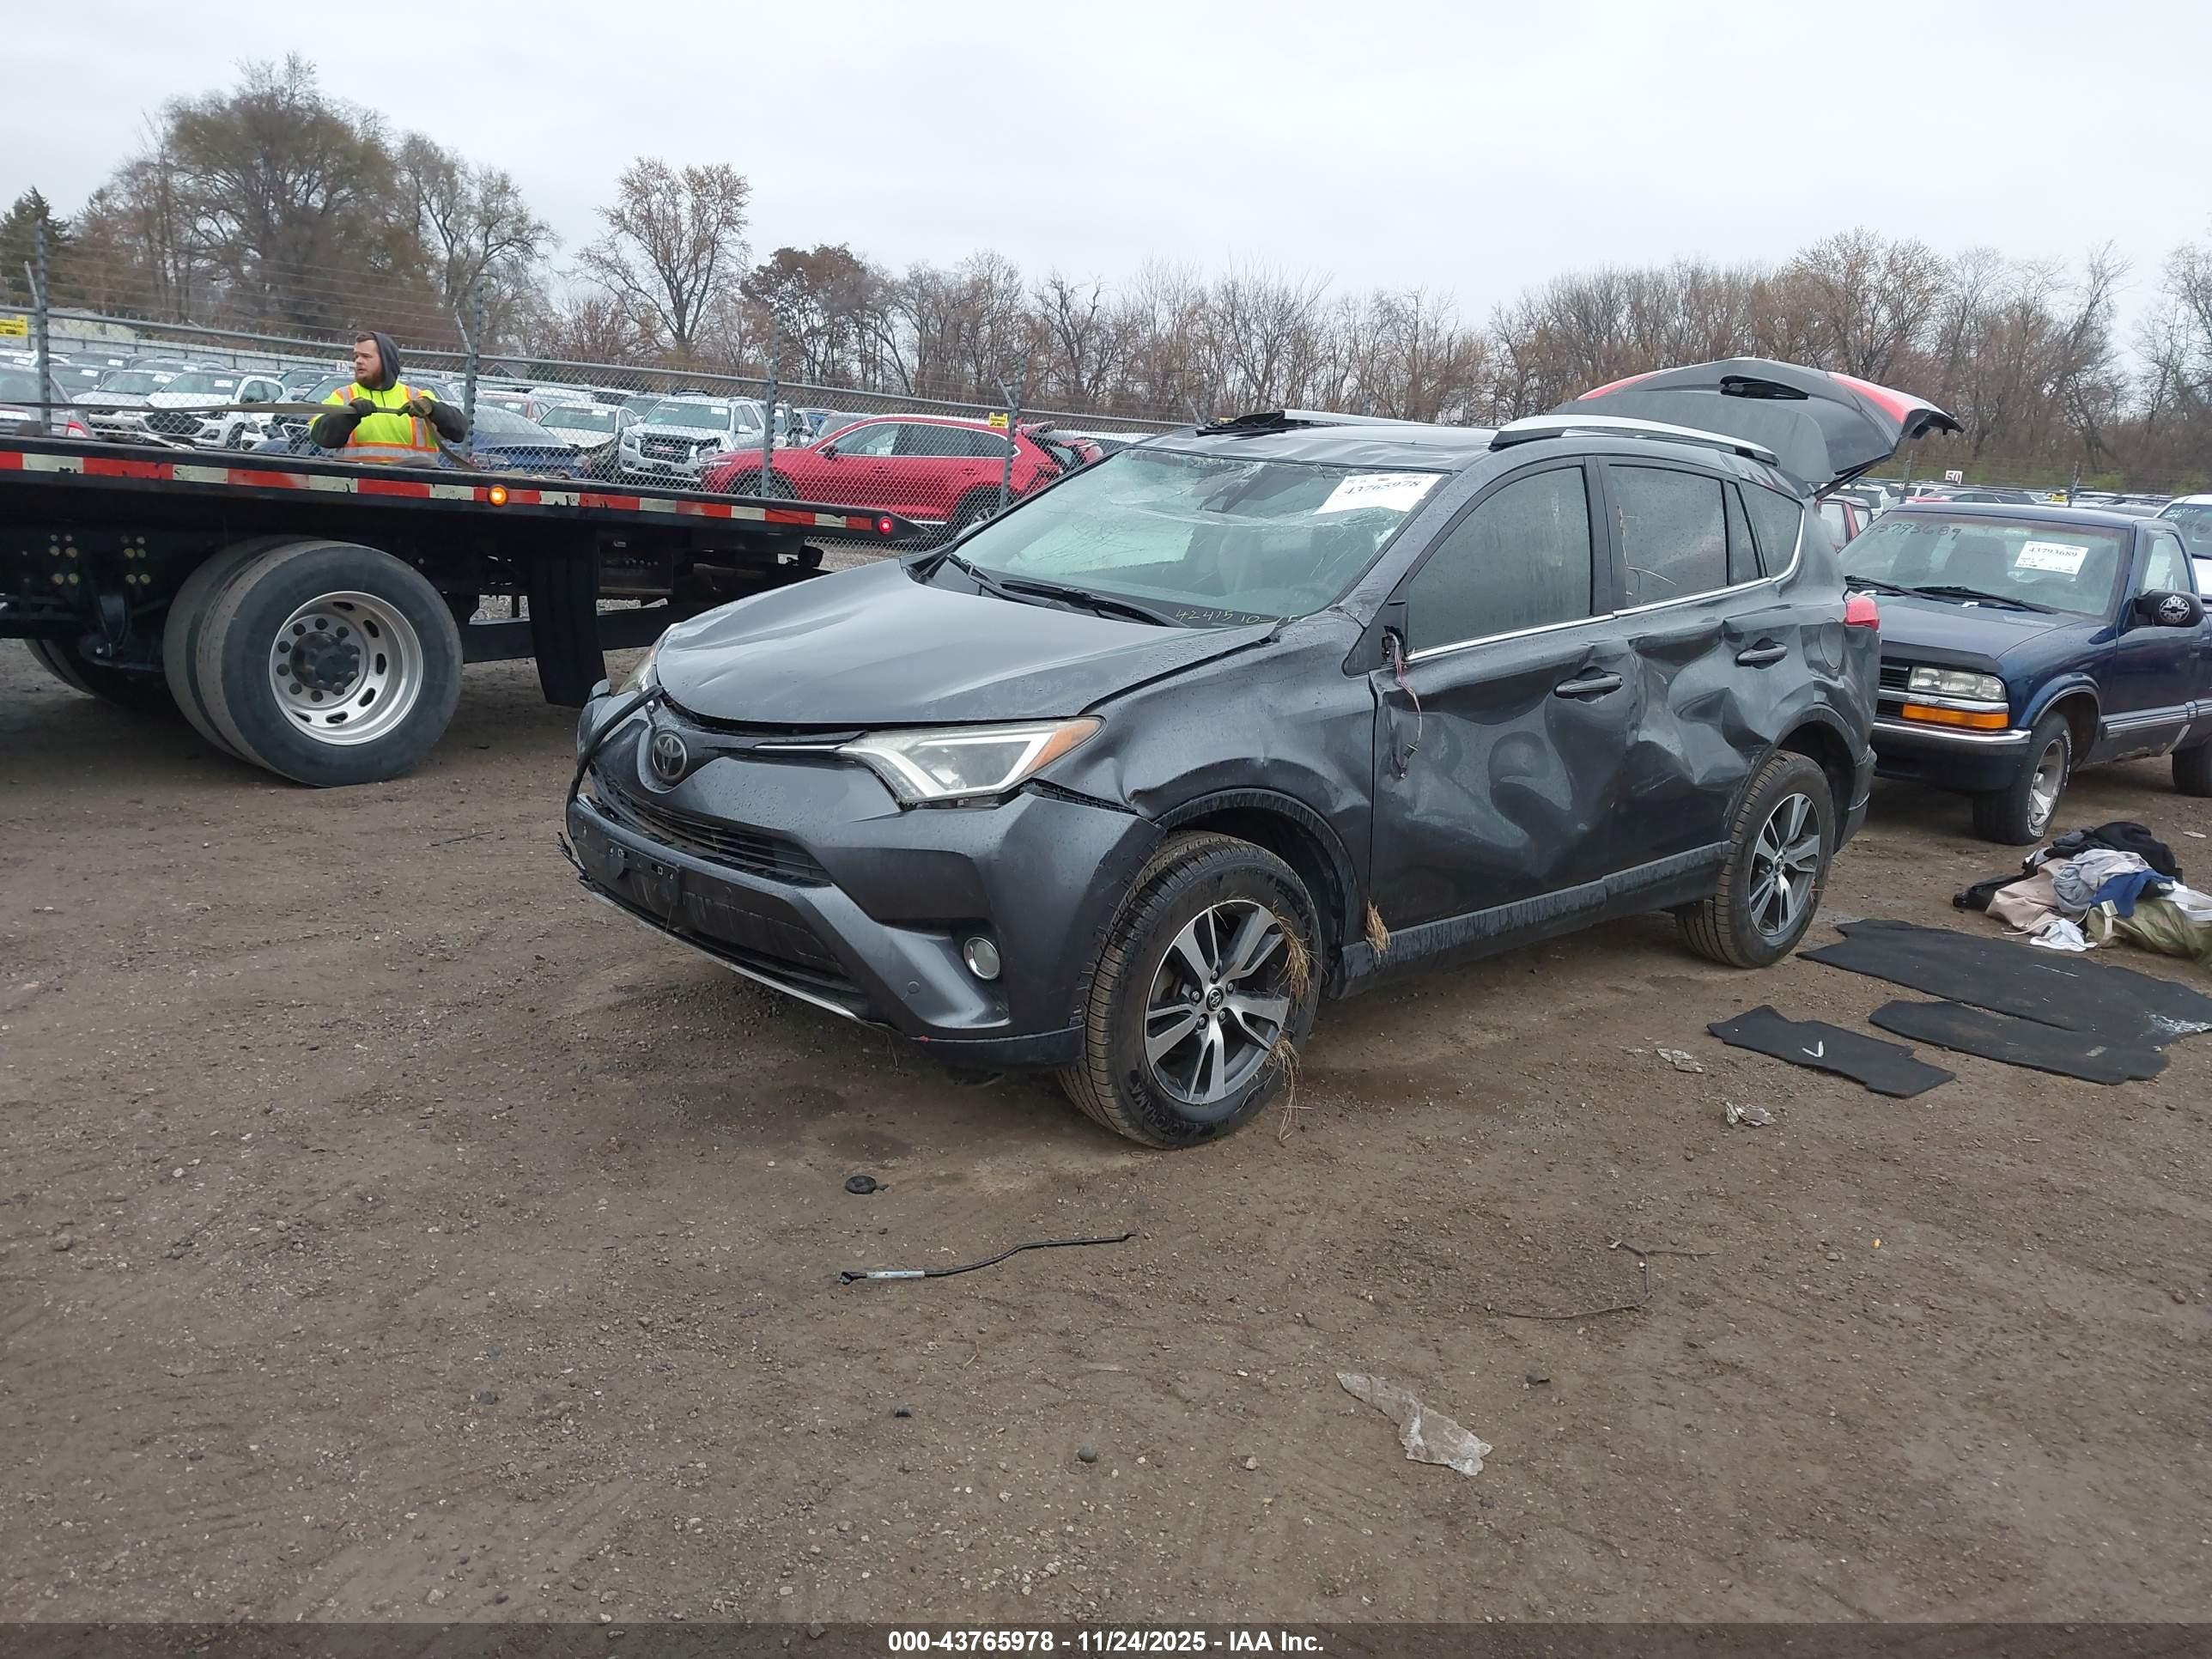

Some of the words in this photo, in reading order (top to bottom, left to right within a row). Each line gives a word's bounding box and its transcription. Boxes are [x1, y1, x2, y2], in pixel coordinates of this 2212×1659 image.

[1343, 481, 1422, 495] 43765978
[1867, 522, 1963, 541] 43793689
[2027, 546, 2079, 557] 43793689
